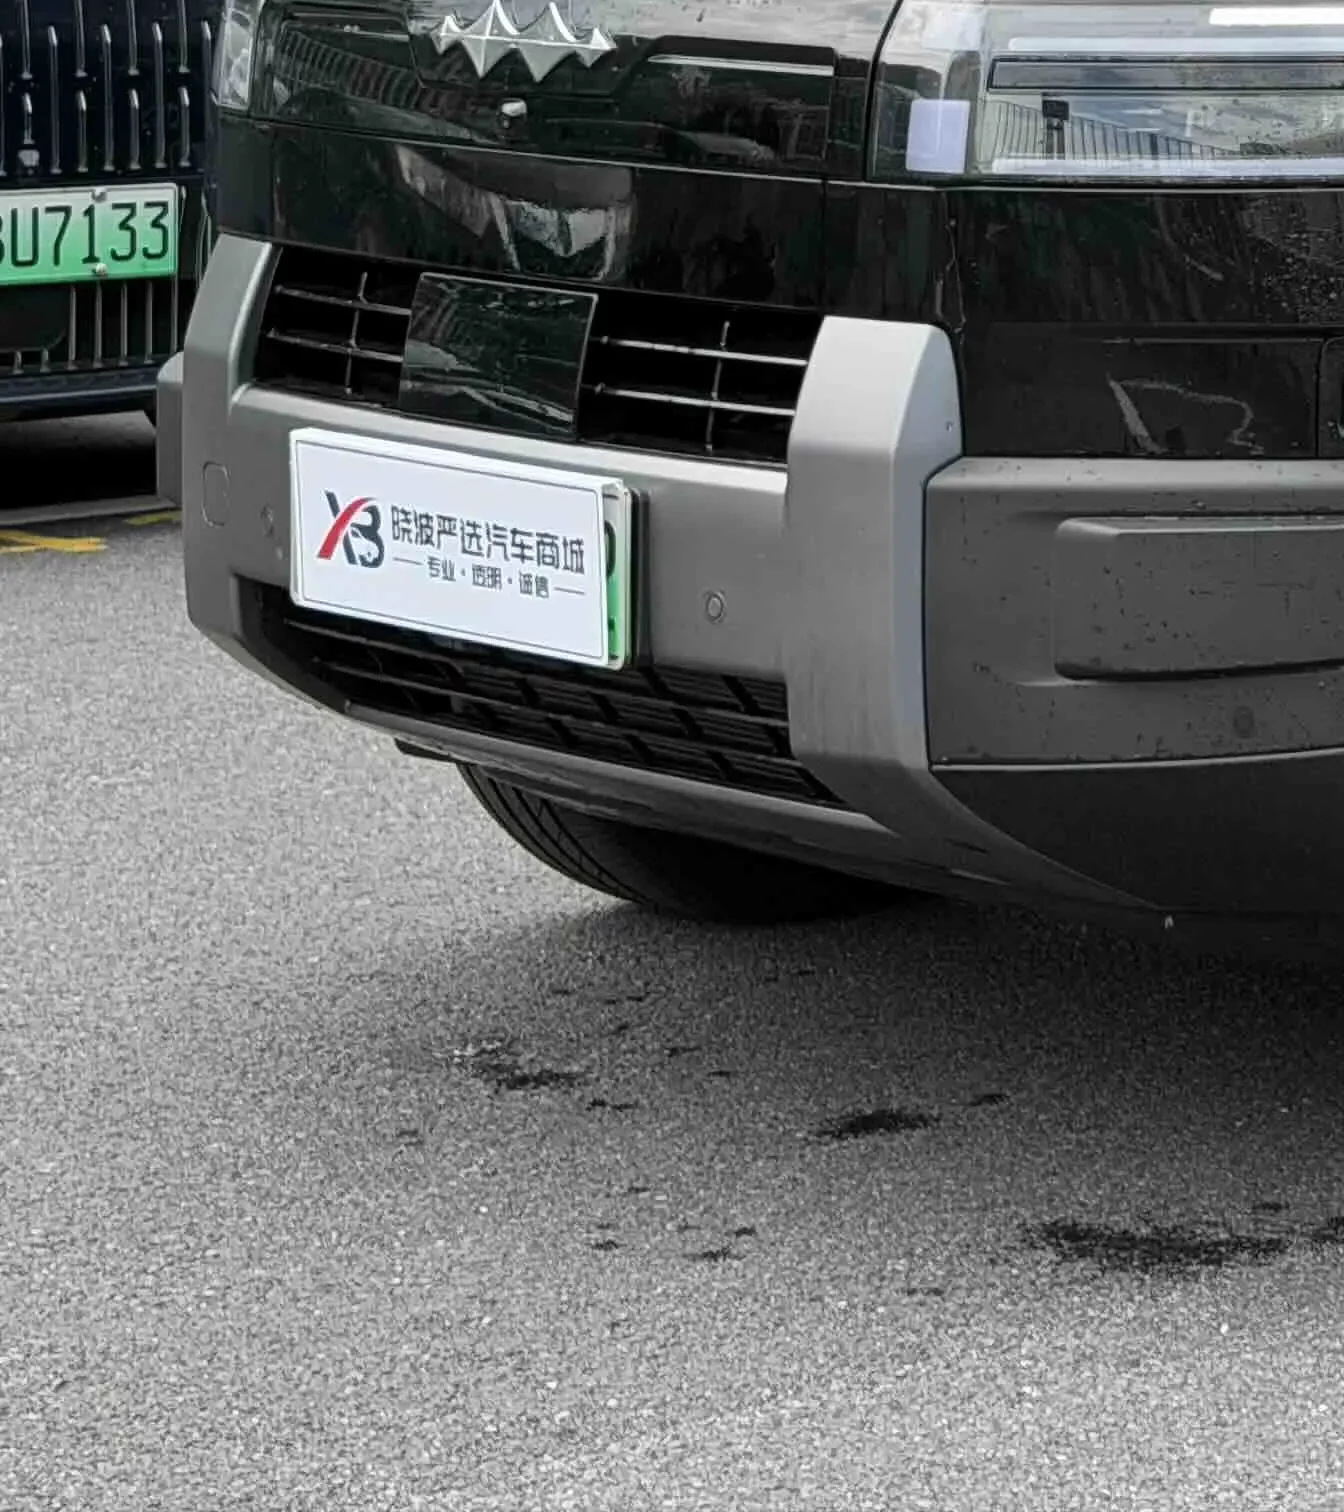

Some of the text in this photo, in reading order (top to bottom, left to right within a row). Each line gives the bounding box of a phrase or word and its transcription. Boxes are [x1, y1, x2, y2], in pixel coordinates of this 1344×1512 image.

[0, 201, 169, 267] U7133
[391, 504, 585, 575] 晓波严选汽车商城
